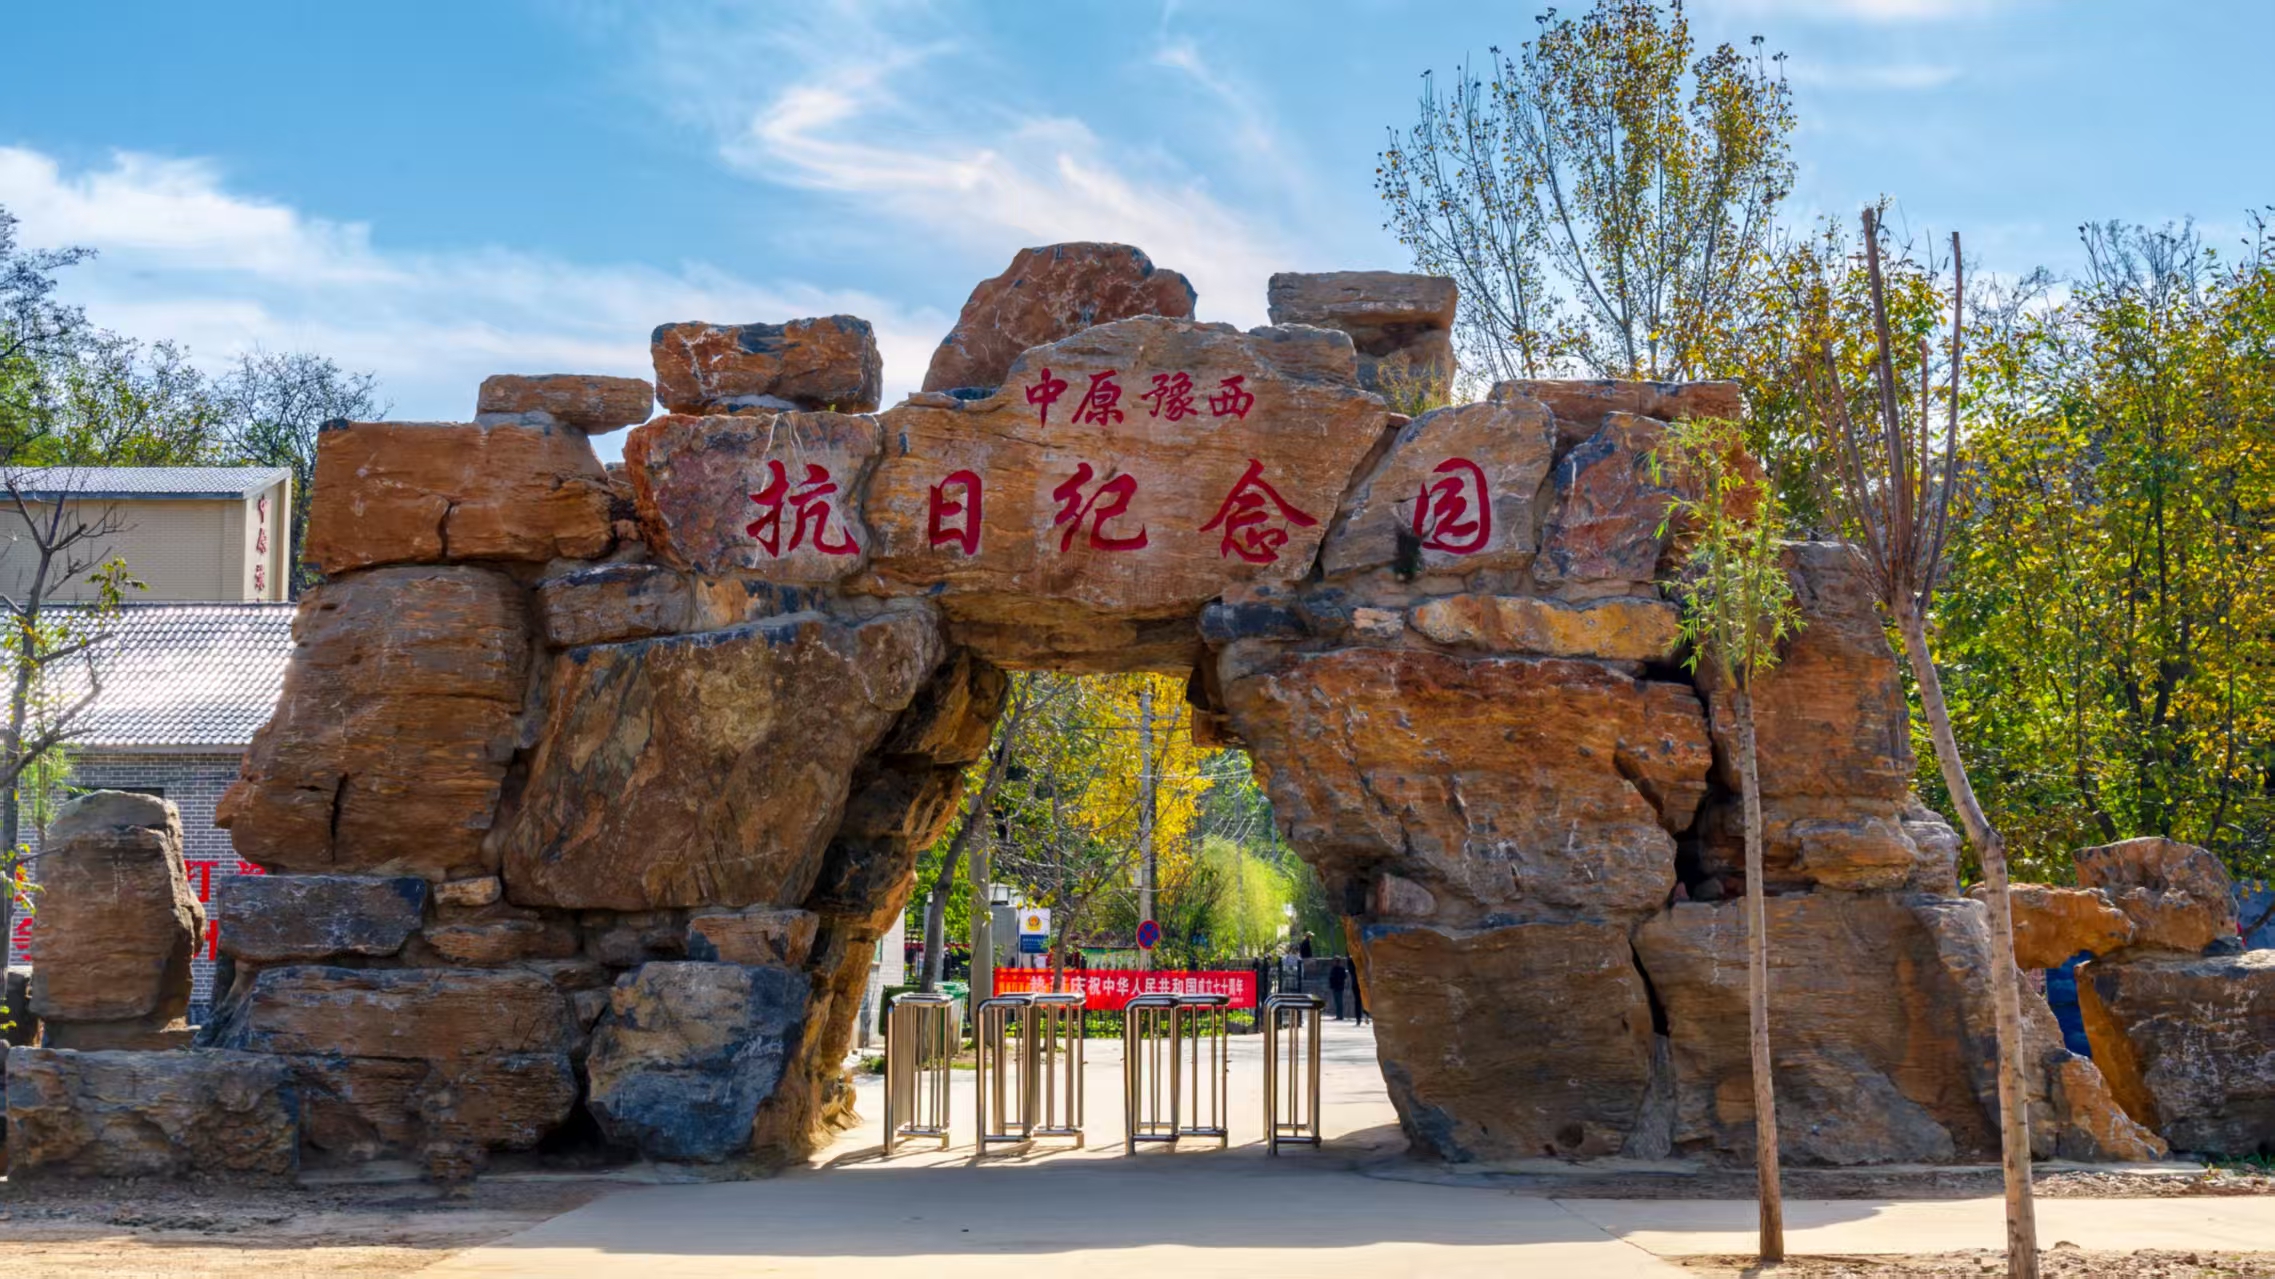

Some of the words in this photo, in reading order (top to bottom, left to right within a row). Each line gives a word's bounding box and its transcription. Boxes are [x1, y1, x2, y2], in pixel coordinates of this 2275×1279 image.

[1025, 368, 1255, 427] 中原豫西
[746, 458, 1491, 566] 抗日纪念园
